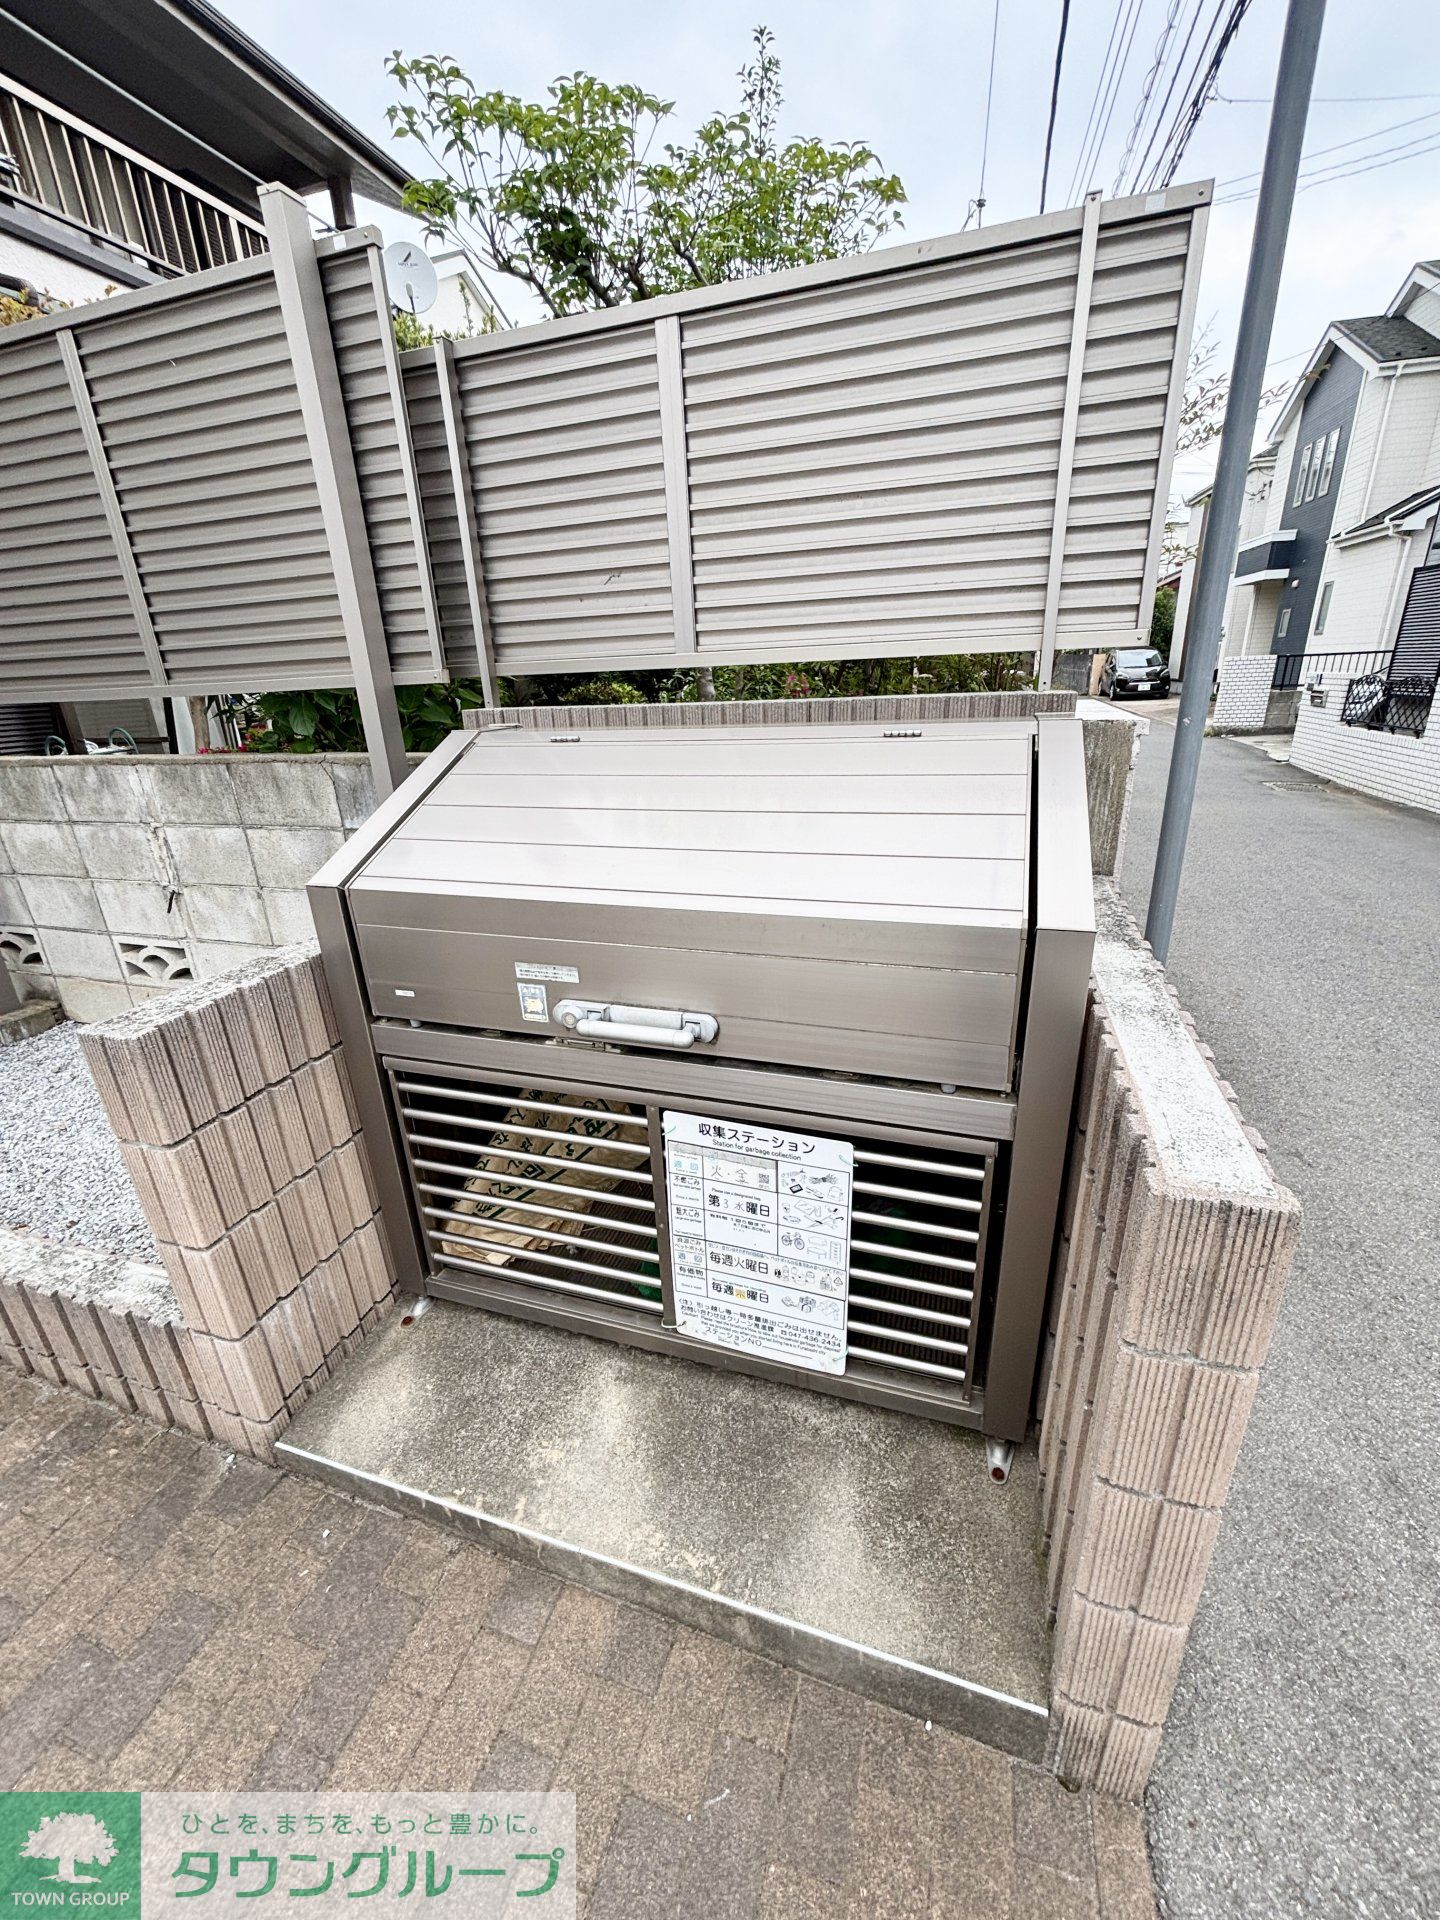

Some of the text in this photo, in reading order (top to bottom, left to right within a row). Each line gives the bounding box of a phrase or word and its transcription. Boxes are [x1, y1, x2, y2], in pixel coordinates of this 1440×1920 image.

[698, 1122, 815, 1155] 収集ステーション
[712, 1139, 733, 1148] Station
[745, 1145, 770, 1156] garbage
[771, 1150, 801, 1161] collection
[709, 1249, 768, 1275] 毎週火曜日
